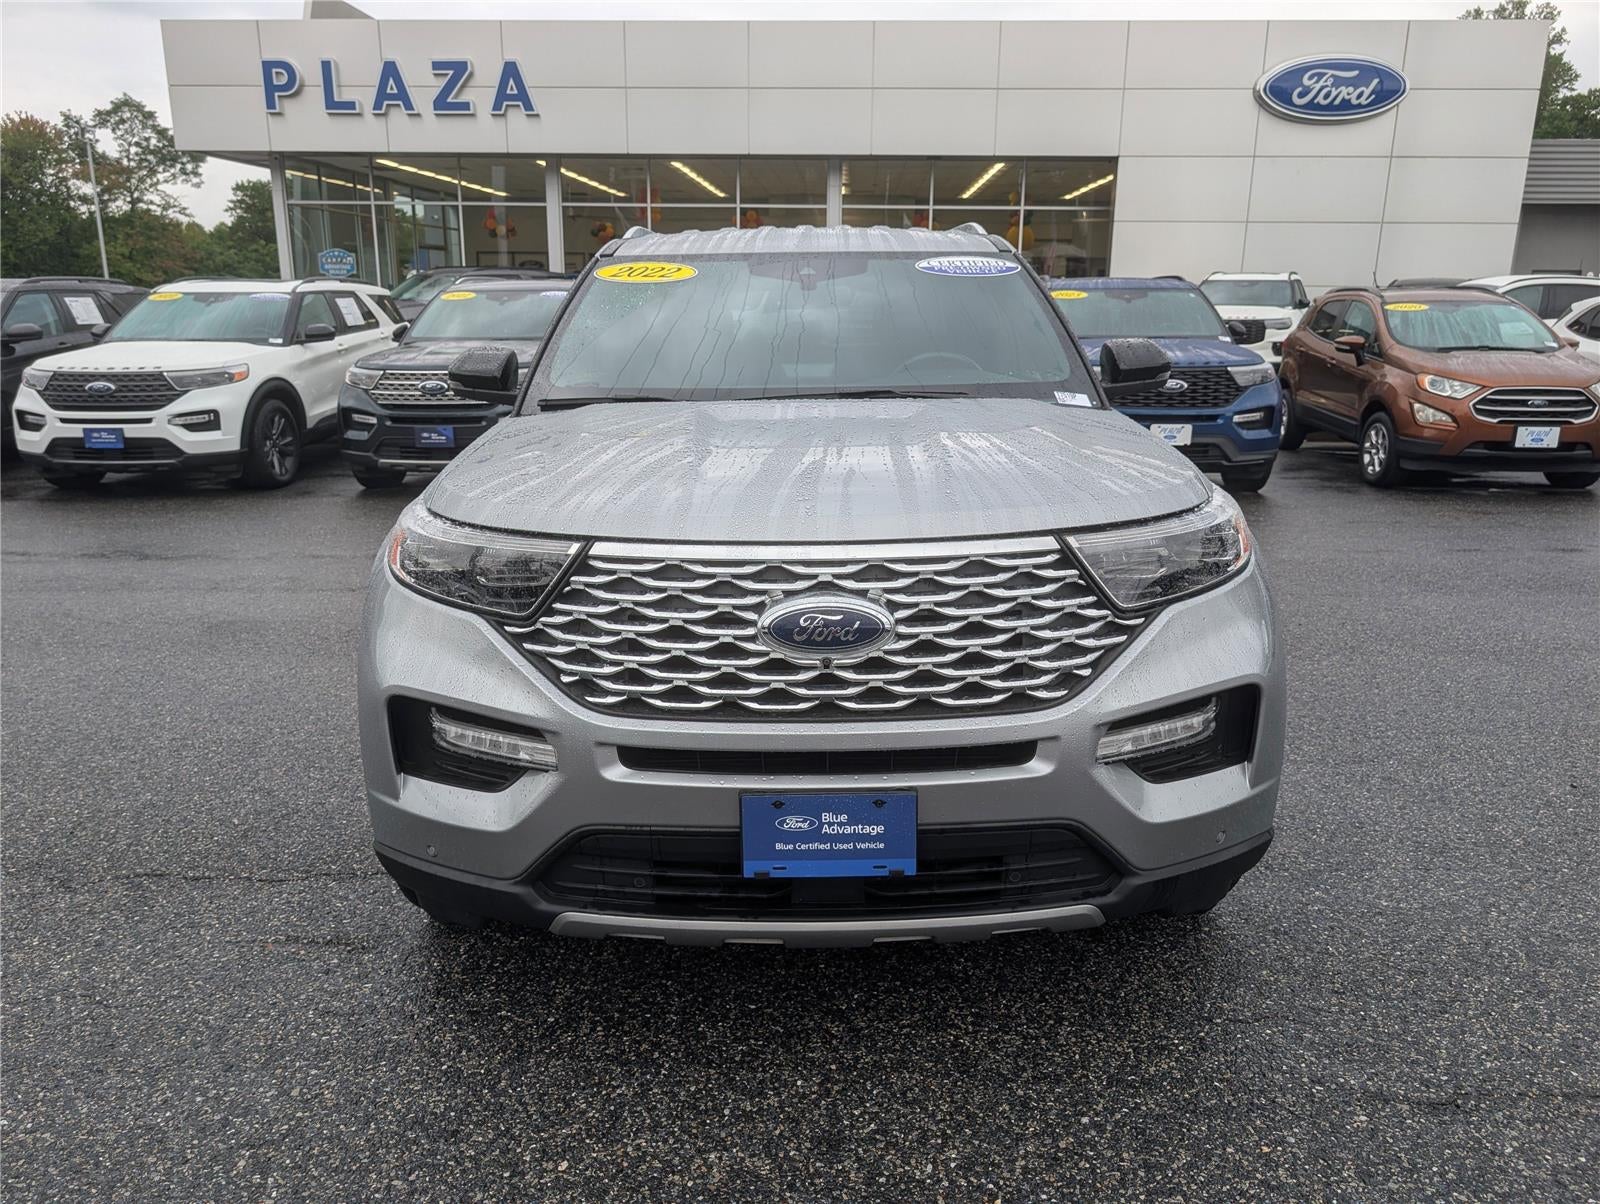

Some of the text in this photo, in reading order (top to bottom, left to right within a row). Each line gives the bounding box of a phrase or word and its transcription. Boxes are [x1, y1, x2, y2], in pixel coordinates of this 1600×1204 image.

[261, 58, 539, 115] PLAZA
[1291, 68, 1380, 106] Ford
[926, 259, 1007, 267] CERTIFIED
[607, 266, 682, 278] 2022
[793, 613, 861, 641] Ford
[783, 812, 848, 829] Ford Blue
[821, 823, 885, 836] Advantage
[775, 841, 885, 850] Blue Certified Used Vehicle
